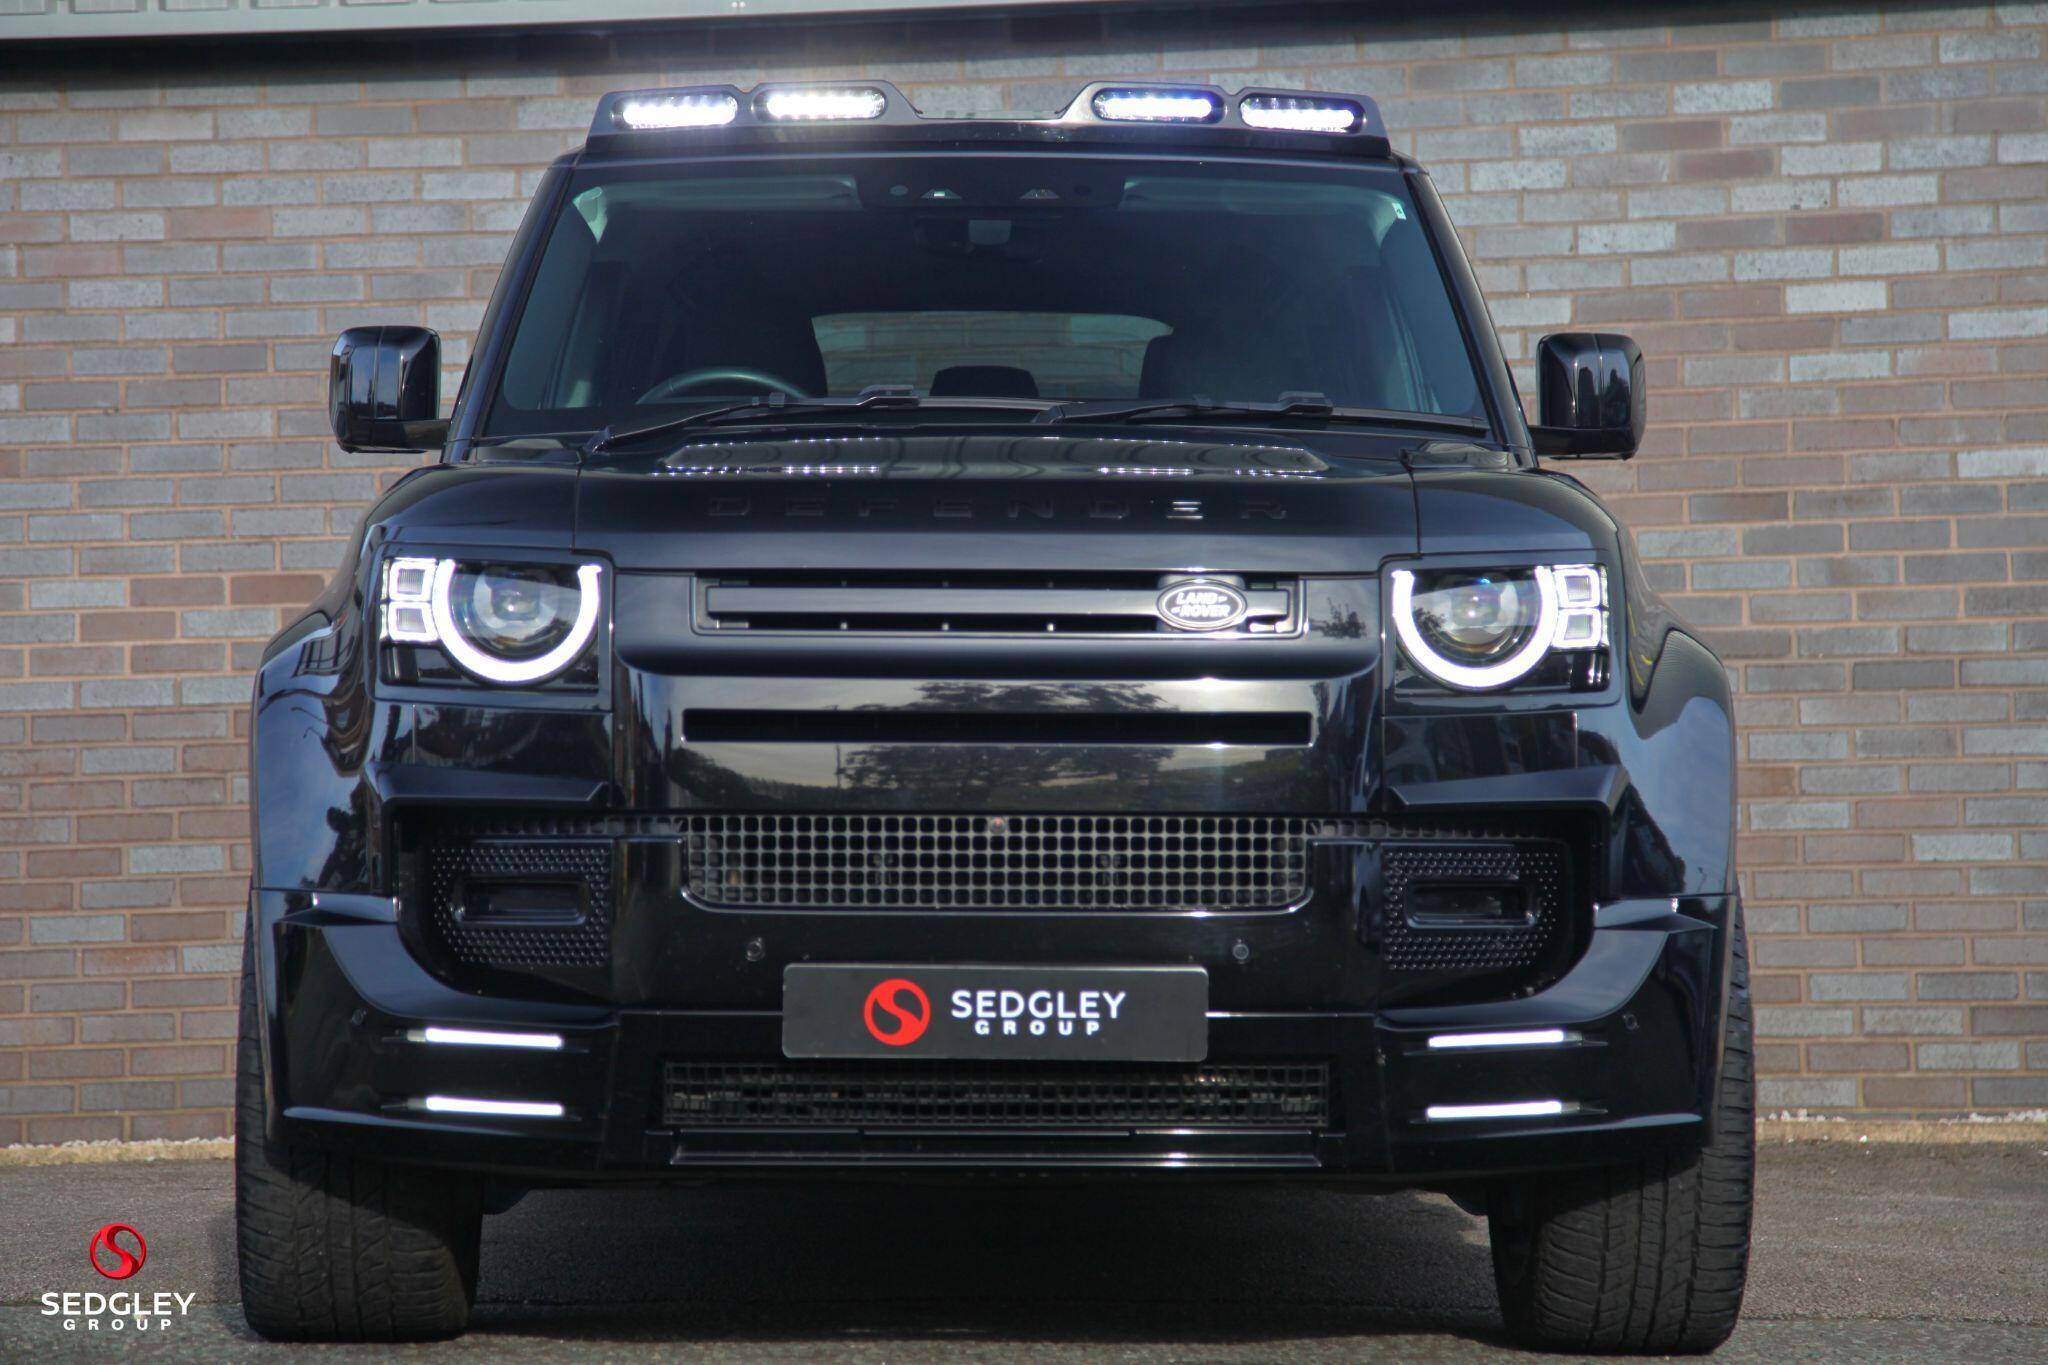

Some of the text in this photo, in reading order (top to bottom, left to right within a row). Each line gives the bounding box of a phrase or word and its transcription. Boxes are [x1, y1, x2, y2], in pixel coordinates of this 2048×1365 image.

[707, 498, 1289, 519] DEFENDER
[1176, 592, 1218, 605] LAND
[1180, 604, 1231, 618] ROVER
[951, 989, 1126, 1019] SEDGLEY
[974, 1019, 1100, 1036] GROUP
